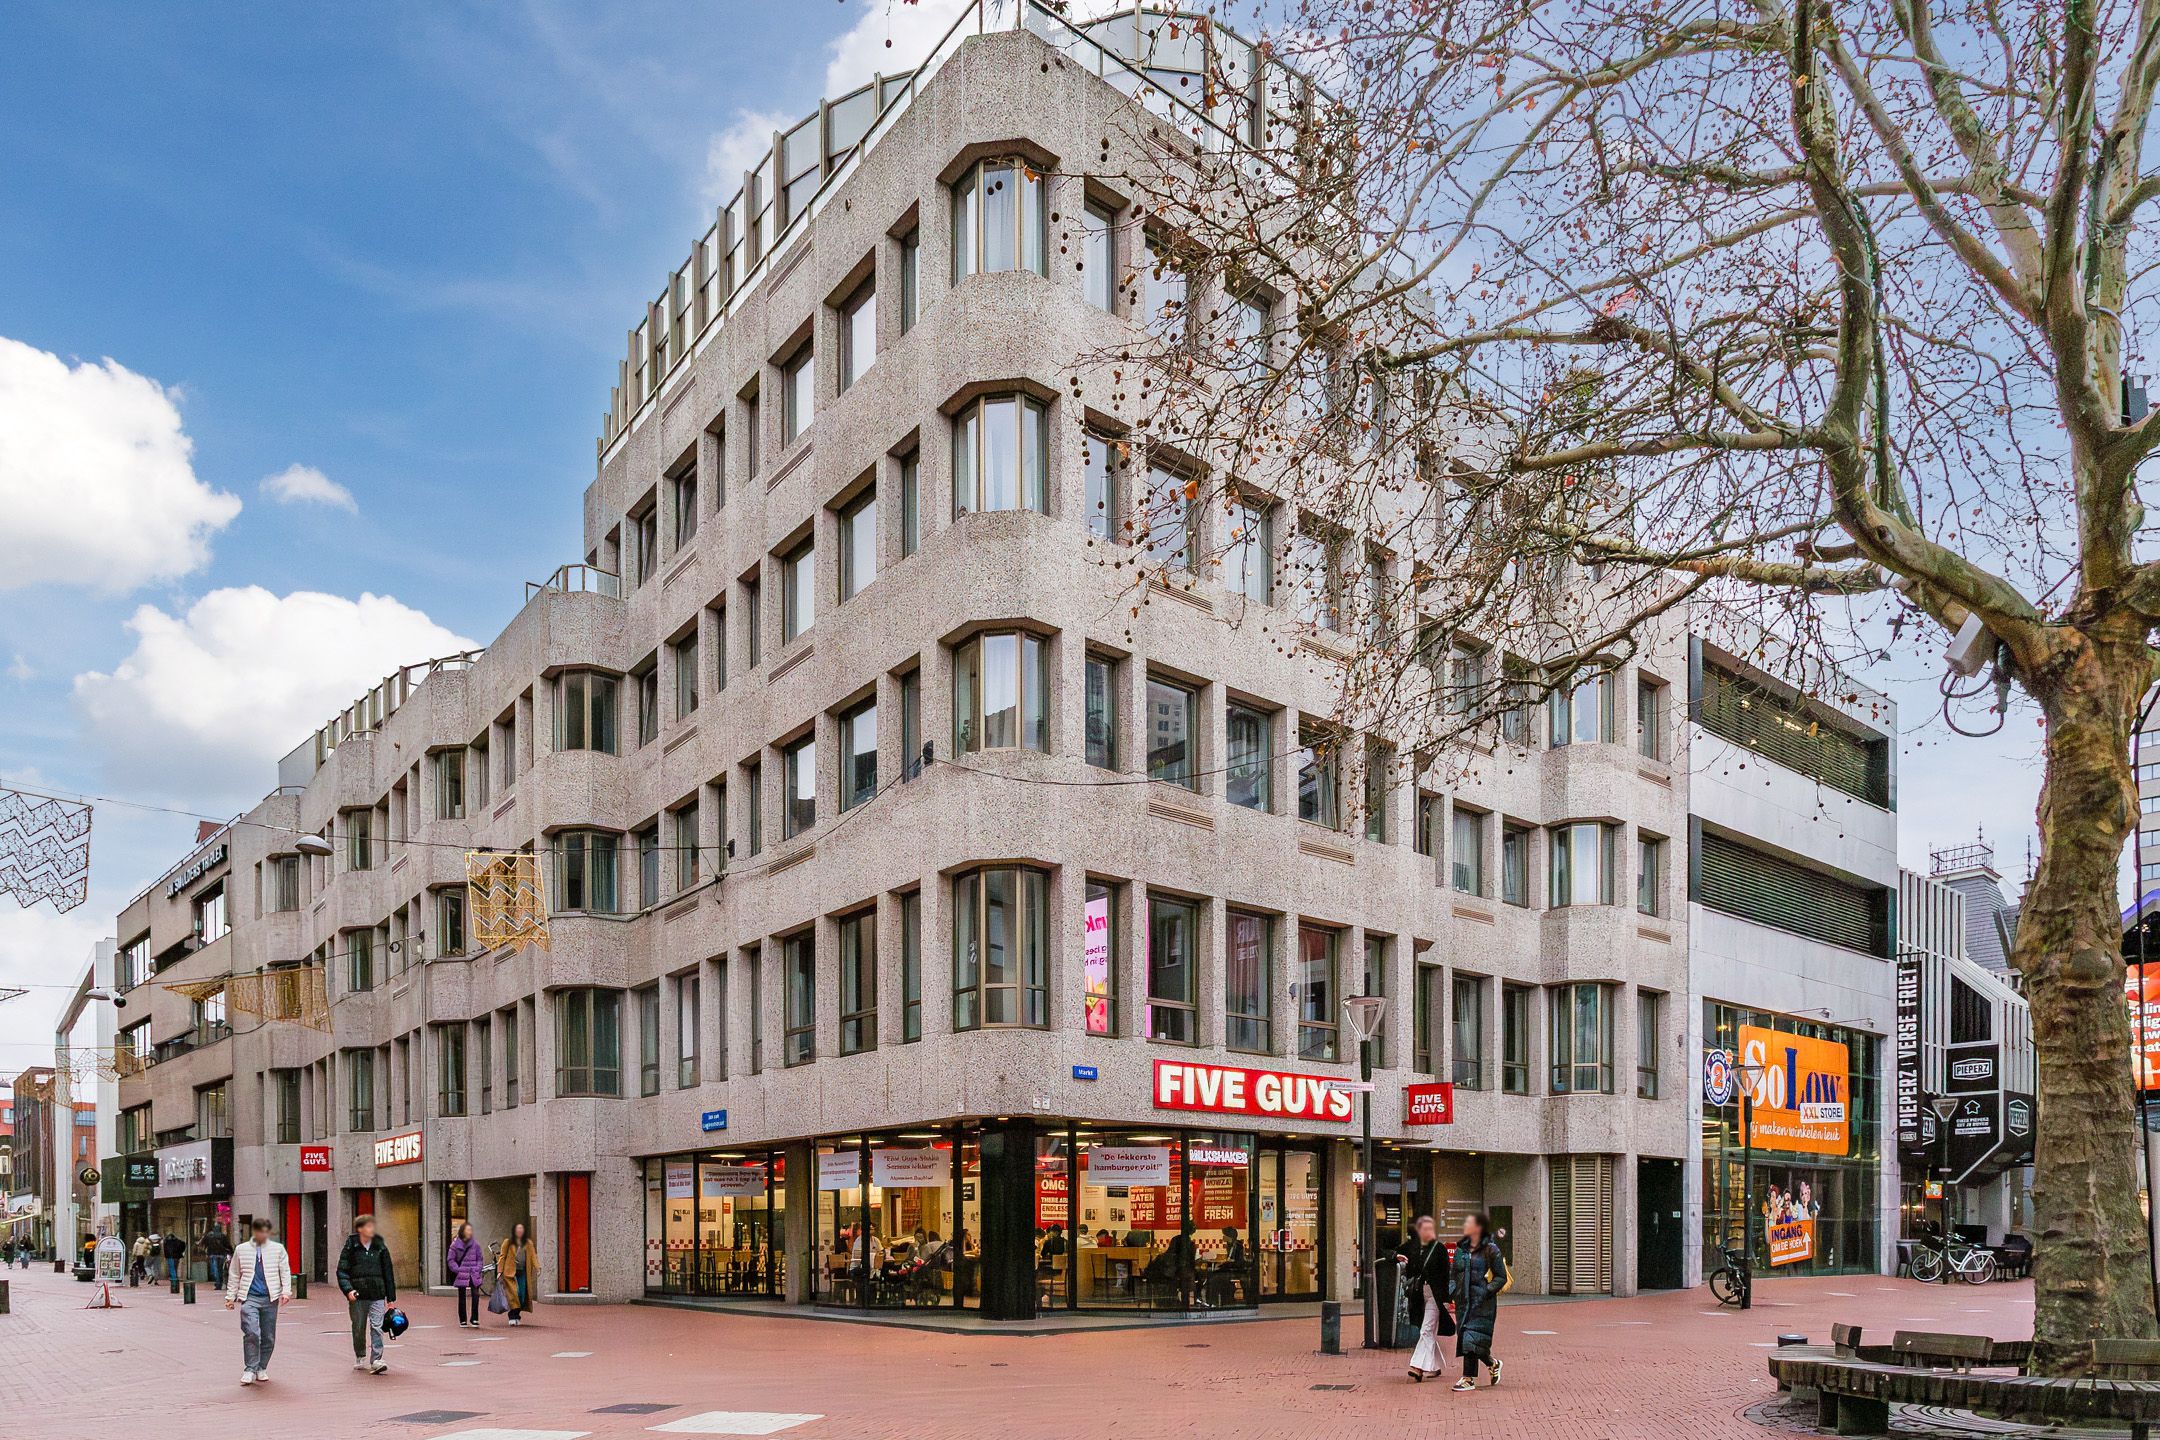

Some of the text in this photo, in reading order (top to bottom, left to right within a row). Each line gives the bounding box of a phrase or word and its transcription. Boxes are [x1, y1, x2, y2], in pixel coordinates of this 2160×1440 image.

[1898, 969, 1917, 1008] FRIET
[1898, 1014, 1917, 1058] VERSE
[1957, 1063, 1989, 1075] PIEPERZ
[1713, 1065, 1724, 1089] 2
[1159, 1064, 1351, 1117] FIVE GUYS
[1414, 1094, 1442, 1104] FIVE
[1899, 1070, 1917, 1127] PIEPERZ
[1411, 1103, 1445, 1114] GUYS
[1803, 1107, 1842, 1119] XXL STORE!
[1760, 1121, 1787, 1136] maken
[1787, 1124, 1823, 1139] winkelen
[1823, 1126, 1840, 1141] leuk
[375, 1134, 420, 1165] FIVE GUYS
[1189, 1149, 1248, 1164] MILKSHAKES
[1094, 1164, 1138, 1172] hamburger
[1041, 1179, 1068, 1191] OMG.
[1131, 1194, 1154, 1202] EATEN
[1131, 1210, 1155, 1221] LIFE!
[1204, 1209, 1233, 1219] FRESH
[1771, 1224, 1803, 1242] INGANG
